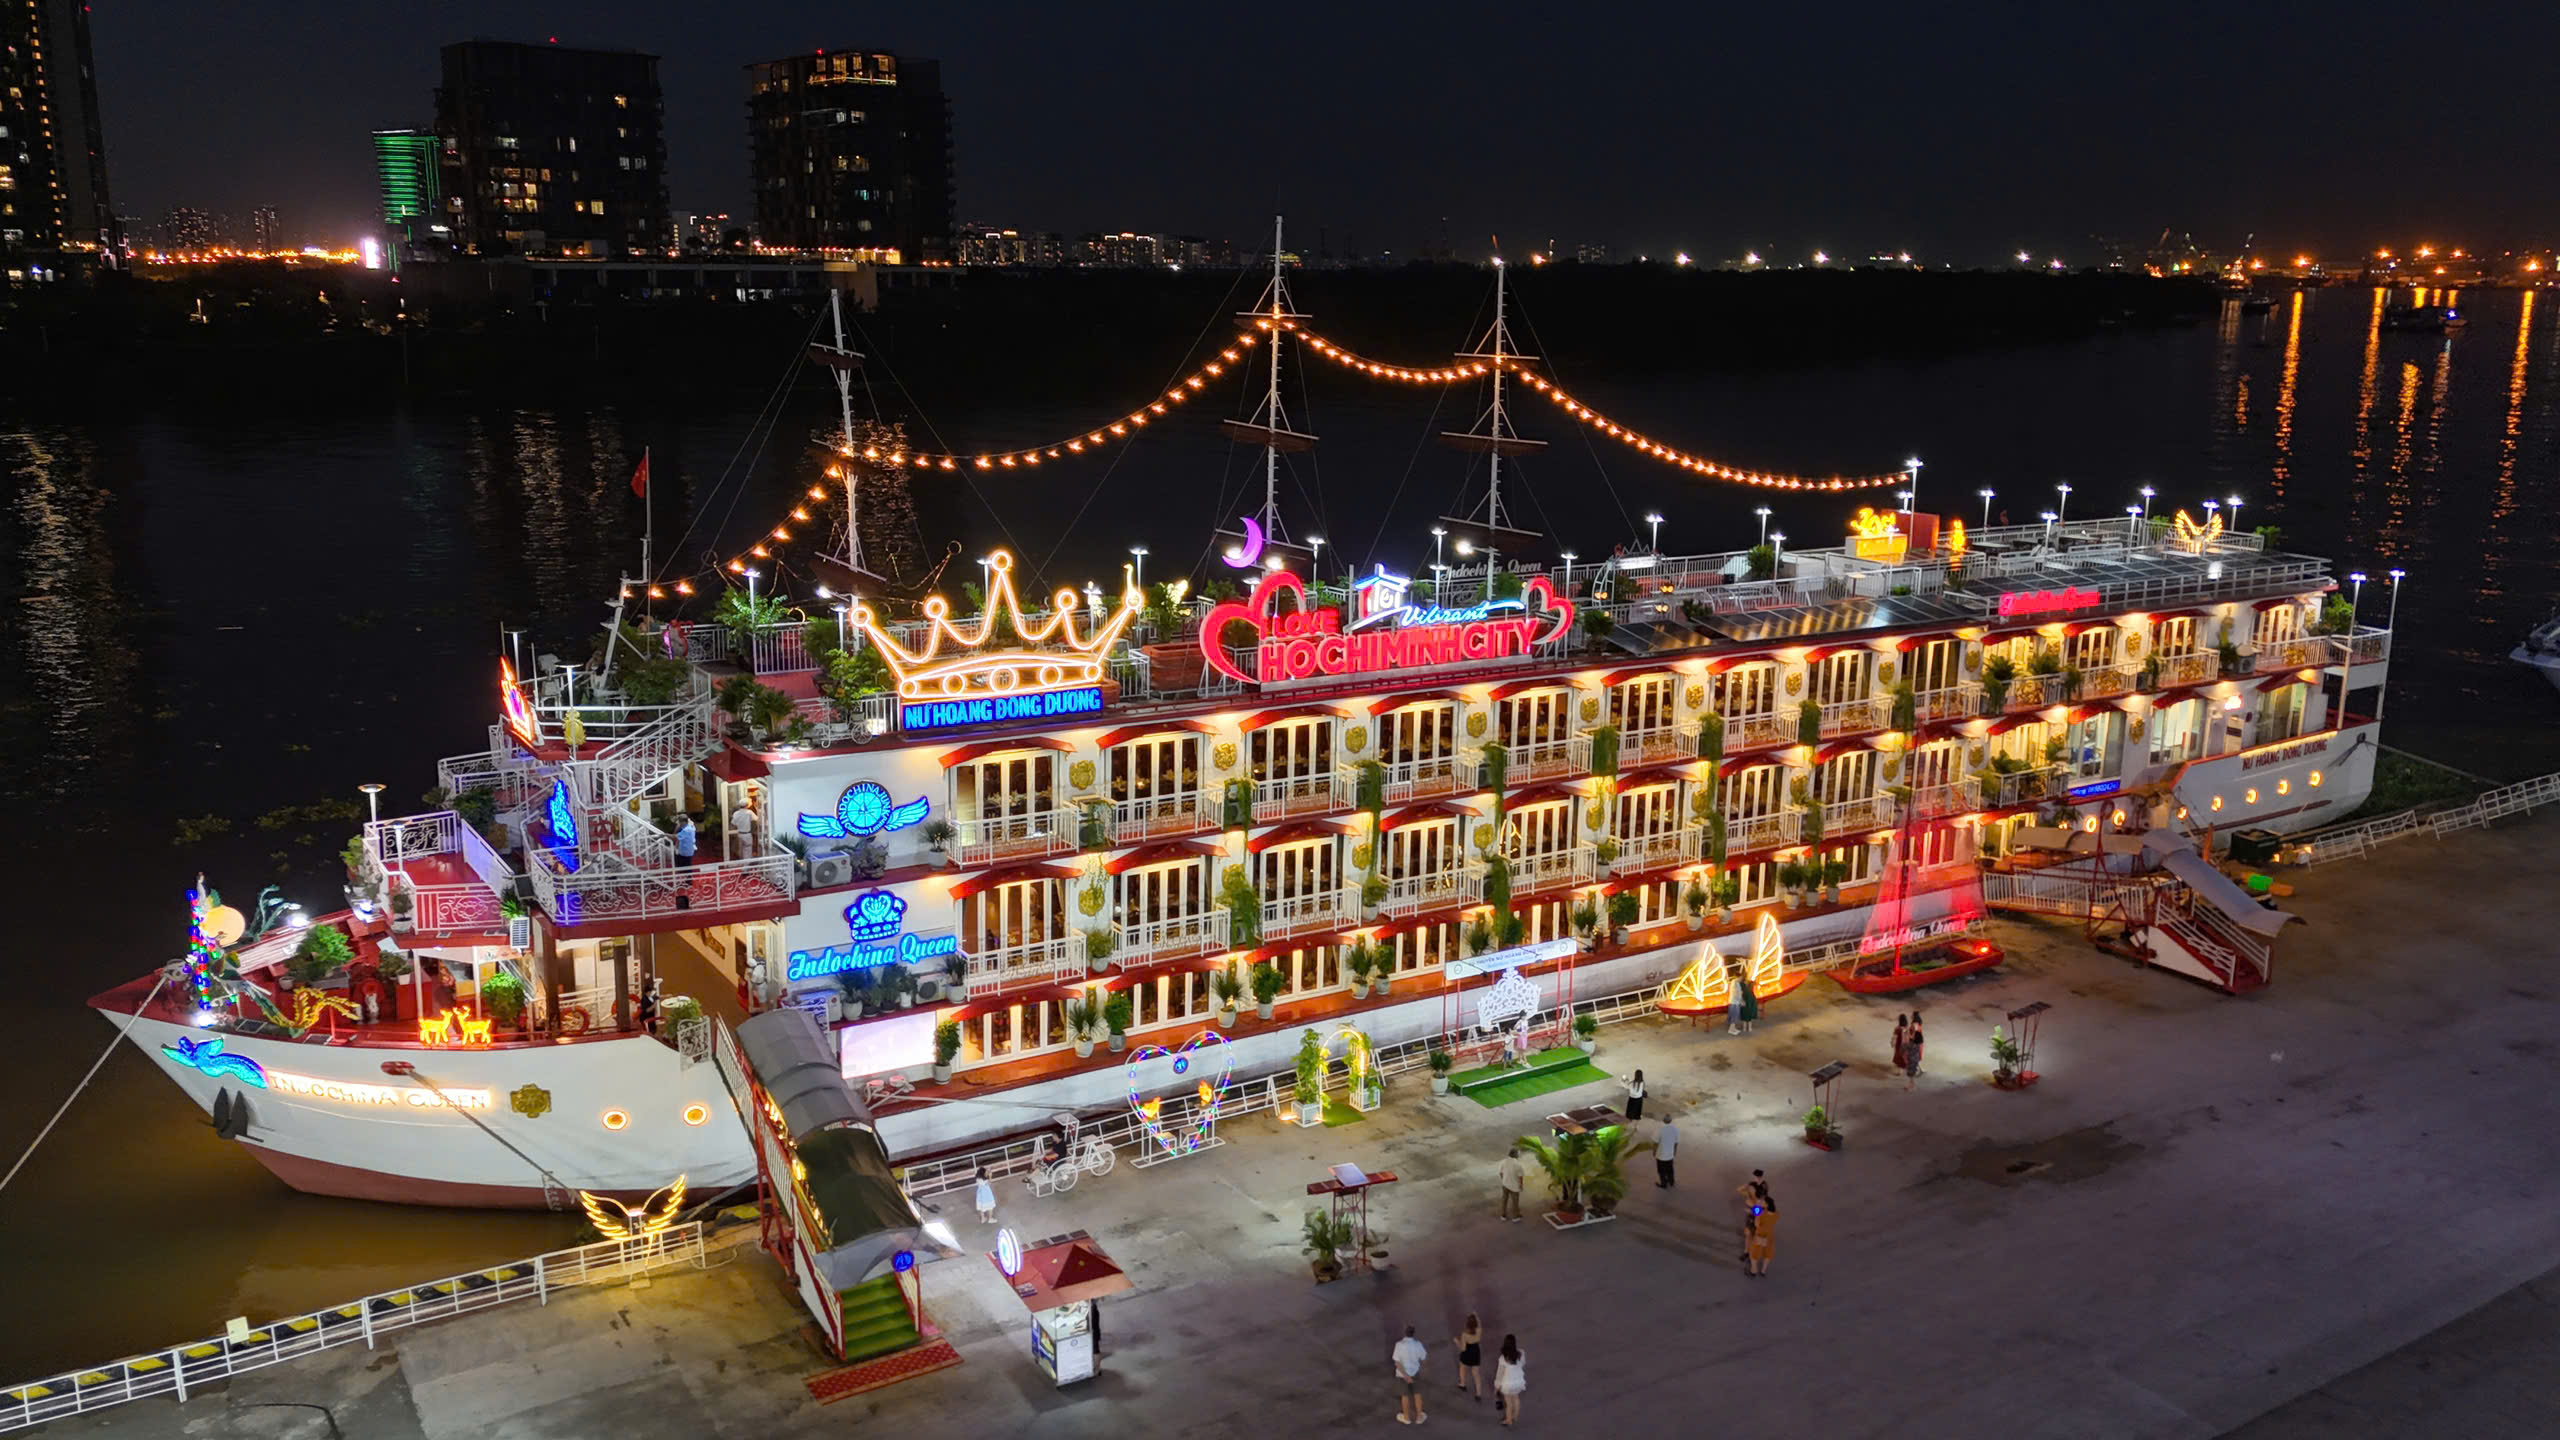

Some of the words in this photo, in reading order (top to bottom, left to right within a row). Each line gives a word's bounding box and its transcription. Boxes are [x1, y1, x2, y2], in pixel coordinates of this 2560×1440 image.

[1440, 562, 1503, 580] Indochia
[1508, 558, 1542, 573] Queen
[1272, 608, 1339, 638] LOVE
[1402, 602, 1495, 627] Vibrant
[788, 943, 896, 980] Indochina
[901, 934, 956, 964] Queen
